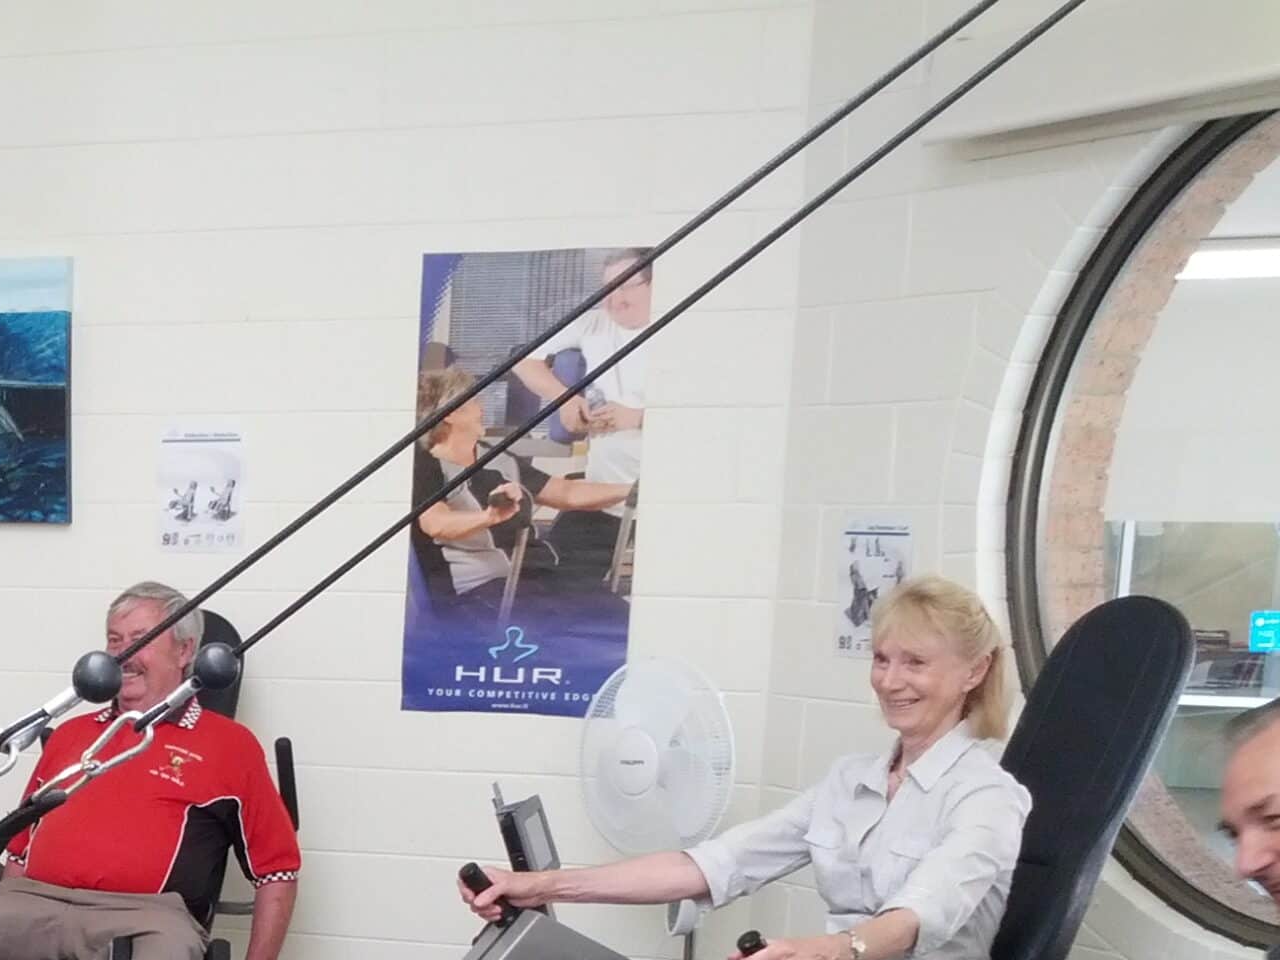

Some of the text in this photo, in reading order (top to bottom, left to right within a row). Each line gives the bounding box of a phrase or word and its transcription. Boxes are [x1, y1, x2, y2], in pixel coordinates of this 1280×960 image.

[455, 665, 562, 685] HUR
[427, 687, 462, 698] YOUR
[468, 688, 556, 701] COMPETITIVE
